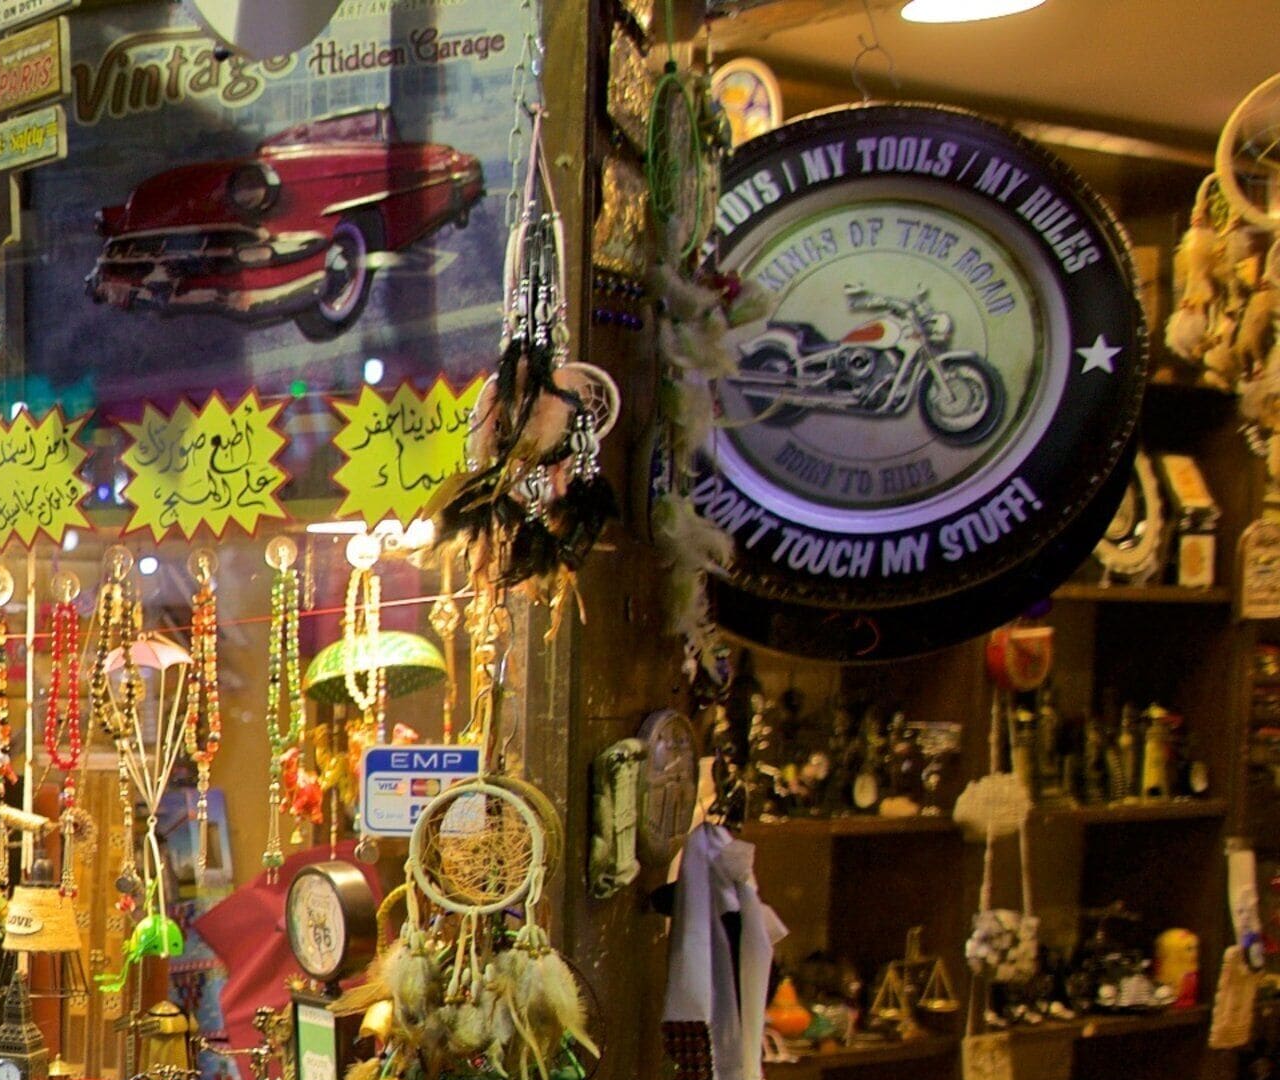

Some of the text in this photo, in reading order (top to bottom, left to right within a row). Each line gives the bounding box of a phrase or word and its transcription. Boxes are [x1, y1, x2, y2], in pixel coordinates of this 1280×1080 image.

[308, 27, 506, 77] Hidden Garage
[801, 140, 846, 186] MY
[856, 135, 960, 177] TOOLS
[974, 156, 1030, 201] MY
[1017, 185, 1101, 276] RULES
[756, 228, 839, 292] KINGS
[848, 217, 886, 249] OF
[895, 218, 960, 260] THE
[952, 246, 1018, 319] ROAD
[773, 441, 937, 496] BORN TO RIDE
[692, 475, 1044, 578] DON'T TOUCH MY STUFF!
[391, 752, 462, 769] EMP
